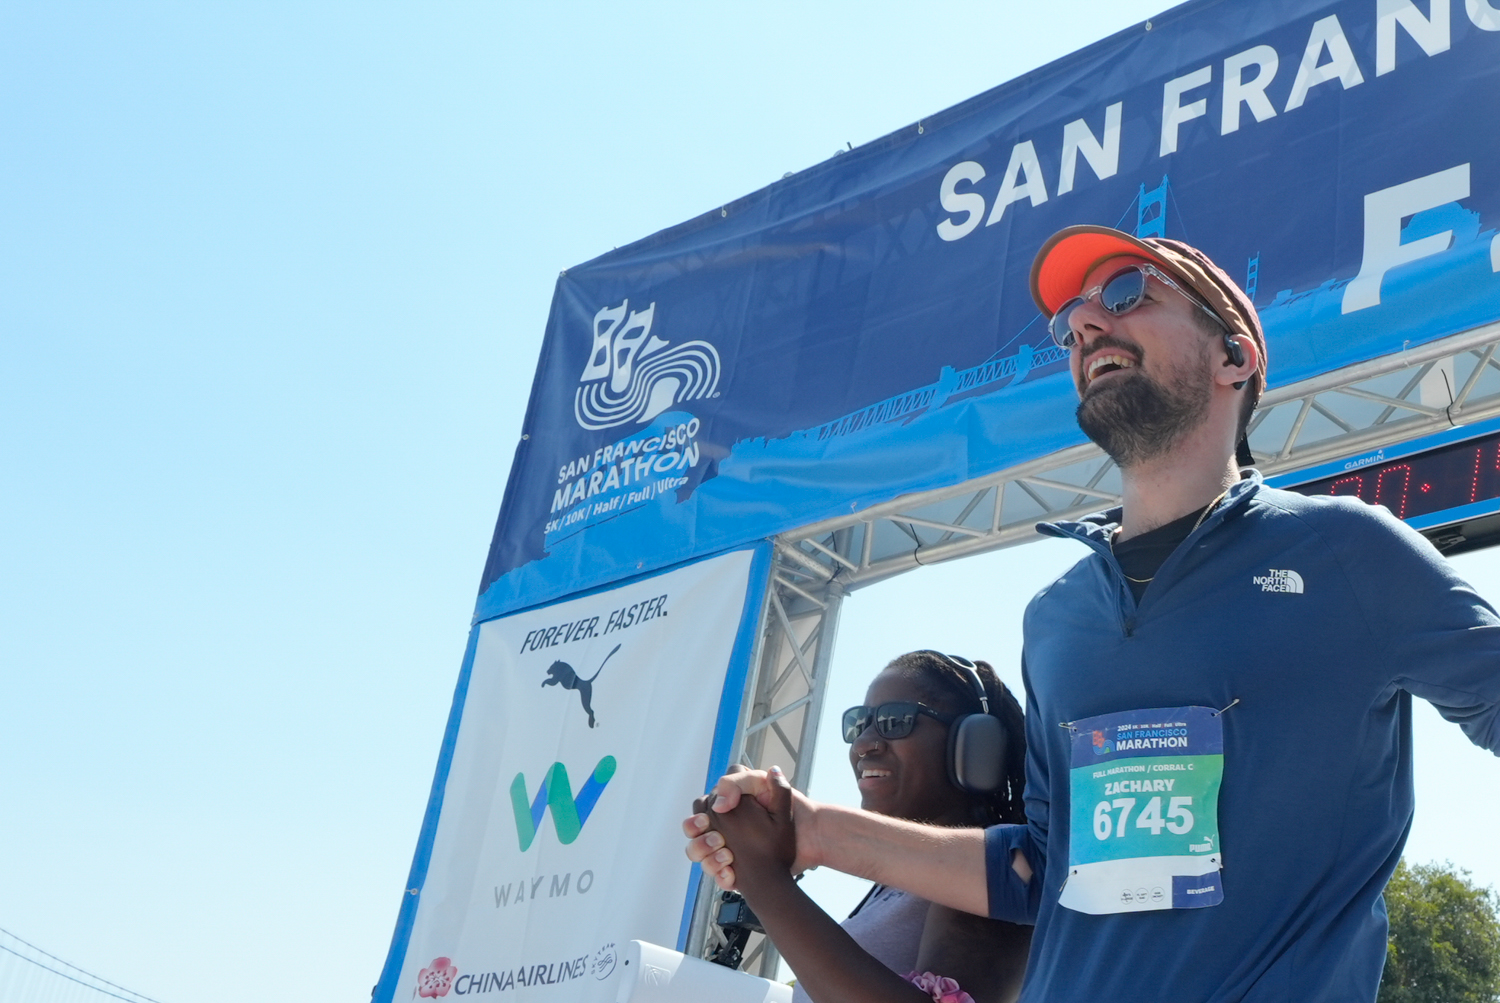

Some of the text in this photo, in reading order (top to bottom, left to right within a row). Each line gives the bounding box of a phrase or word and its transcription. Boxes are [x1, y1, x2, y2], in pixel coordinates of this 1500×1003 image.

[936, 101, 1123, 241] SAN
[558, 417, 700, 484] SAN FRANCISCO
[1344, 453, 1384, 470] GARMIN
[550, 441, 700, 513] MARATHON
[593, 495, 620, 515] Half
[627, 485, 650, 505] Full
[657, 476, 689, 494] Ultra
[1253, 576, 1286, 585] NORTH
[1269, 569, 1288, 577] THE
[1262, 584, 1286, 592] FACE
[520, 594, 668, 655] FOREVER. FASTER.
[1117, 728, 1187, 740] SAN FRANCISCO
[1117, 737, 1187, 751] MARATHON
[1093, 771, 1106, 779] FULL
[1107, 765, 1145, 775] MARATHON
[1153, 764, 1186, 772] CORRAL
[1105, 779, 1175, 796] ZACHARY
[1093, 796, 1195, 841] 6745
[494, 869, 595, 909] WAYMO
